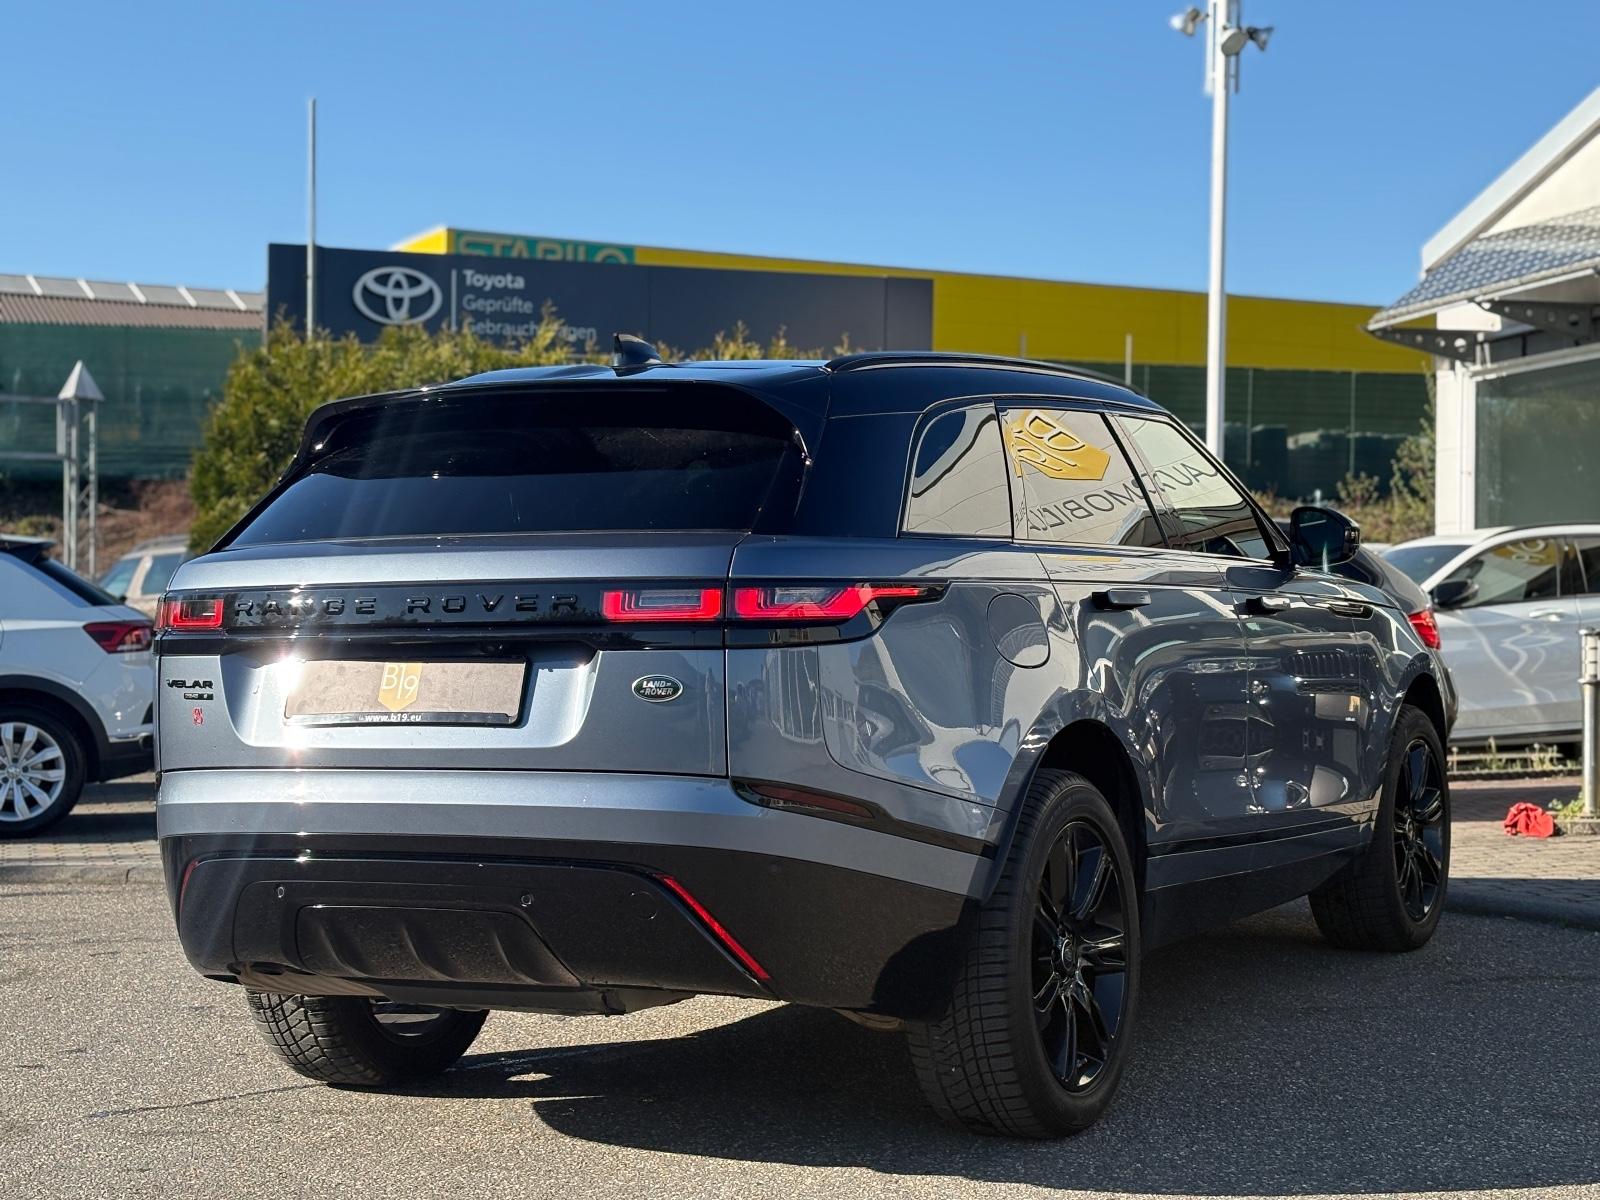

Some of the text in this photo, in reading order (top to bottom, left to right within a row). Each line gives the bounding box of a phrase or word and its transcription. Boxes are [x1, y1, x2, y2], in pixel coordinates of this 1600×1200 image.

[462, 269, 525, 291] Toyota
[462, 294, 533, 314] Geprüfte
[463, 318, 597, 342] ebrauchagen
[406, 594, 579, 615] ROVER
[382, 664, 419, 699] B19
[642, 680, 666, 688] LAND
[644, 687, 674, 696] ROVER
[365, 713, 422, 722] www.b19.eu
